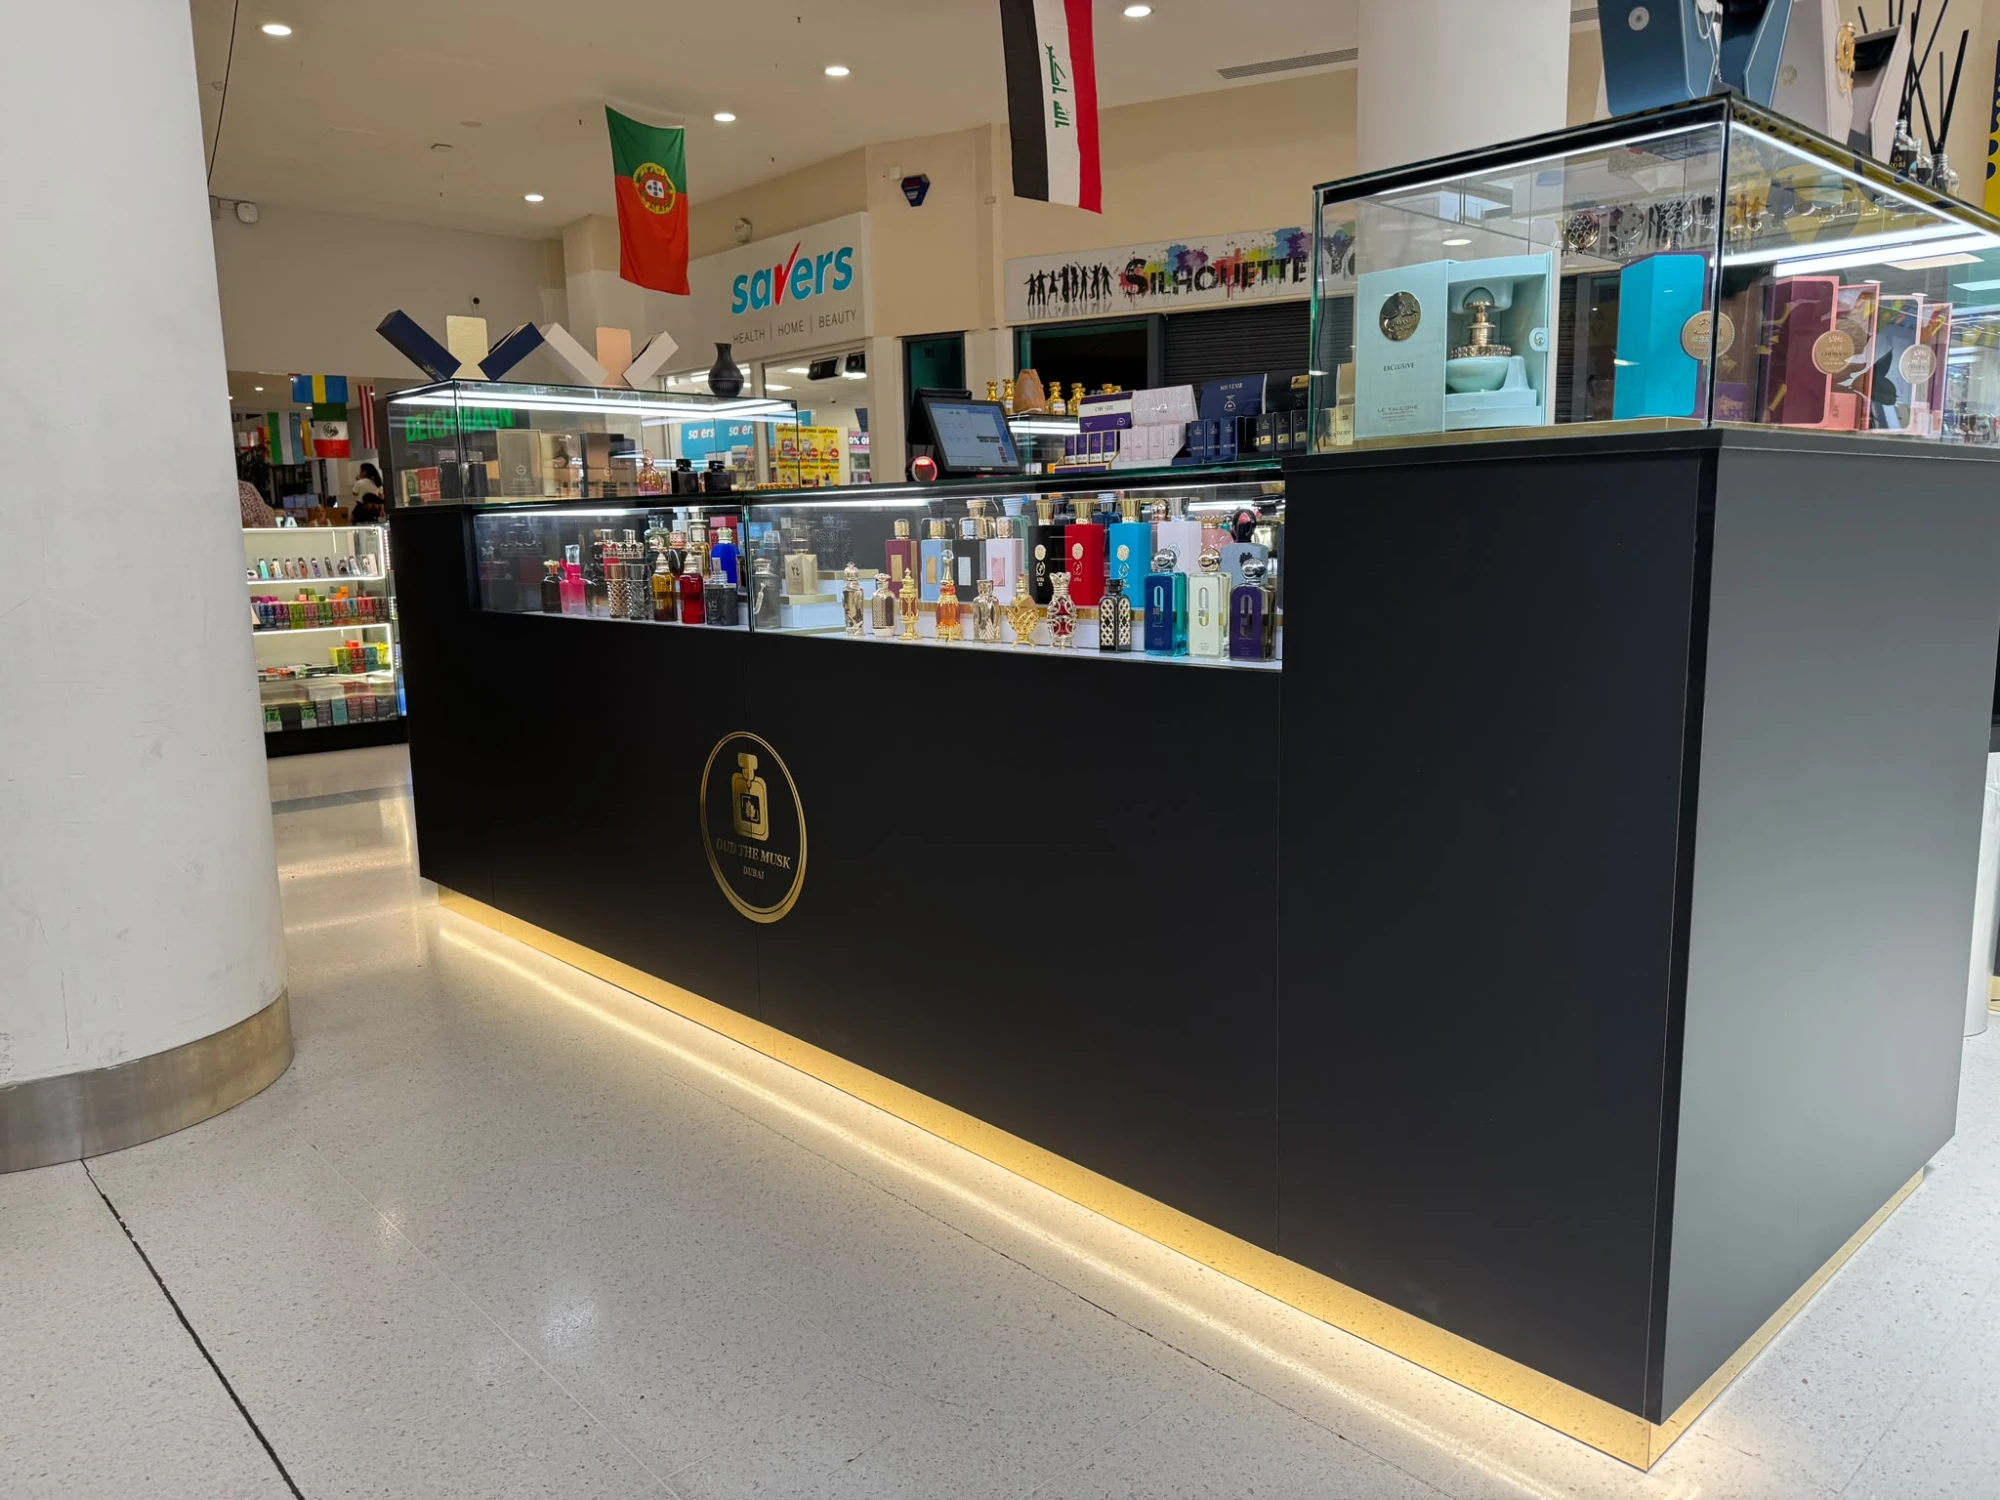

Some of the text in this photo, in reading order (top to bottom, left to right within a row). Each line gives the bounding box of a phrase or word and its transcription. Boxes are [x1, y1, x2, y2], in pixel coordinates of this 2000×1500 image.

[732, 241, 853, 315] savers
[1125, 256, 1306, 295] SILHOUETTE
[733, 309, 857, 344] HEALTH HOME BEAUTY
[1383, 362, 1415, 372] EXCLUSIVE
[729, 423, 754, 437] saver
[420, 478, 437, 492] SALE
[716, 838, 791, 870] OUD THE MUSK
[743, 865, 764, 880] DUBAI
